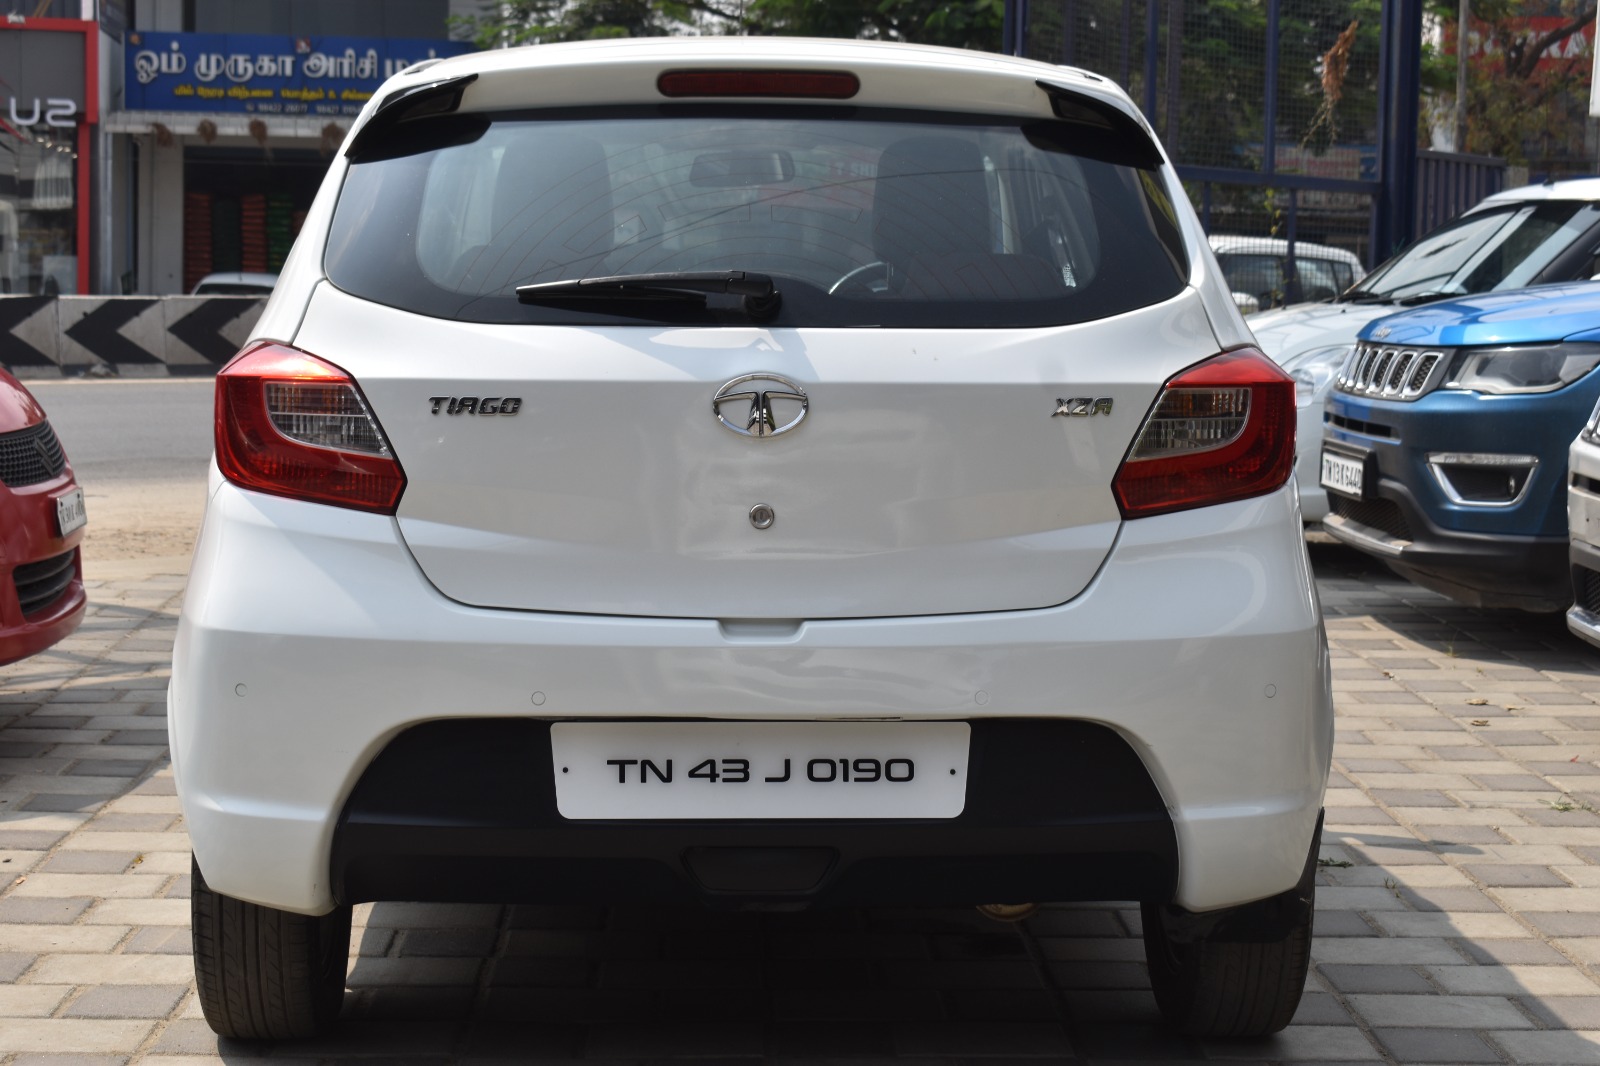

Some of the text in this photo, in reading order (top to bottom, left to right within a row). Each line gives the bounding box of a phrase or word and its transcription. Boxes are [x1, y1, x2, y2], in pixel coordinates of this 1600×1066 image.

[134, 41, 187, 84] ஓம்
[194, 51, 297, 83] முருகா
[302, 47, 379, 79] அரிசி
[428, 396, 523, 418] TIAGO
[1050, 396, 1114, 418] XZA
[607, 758, 914, 783] TN 43 J 0190
